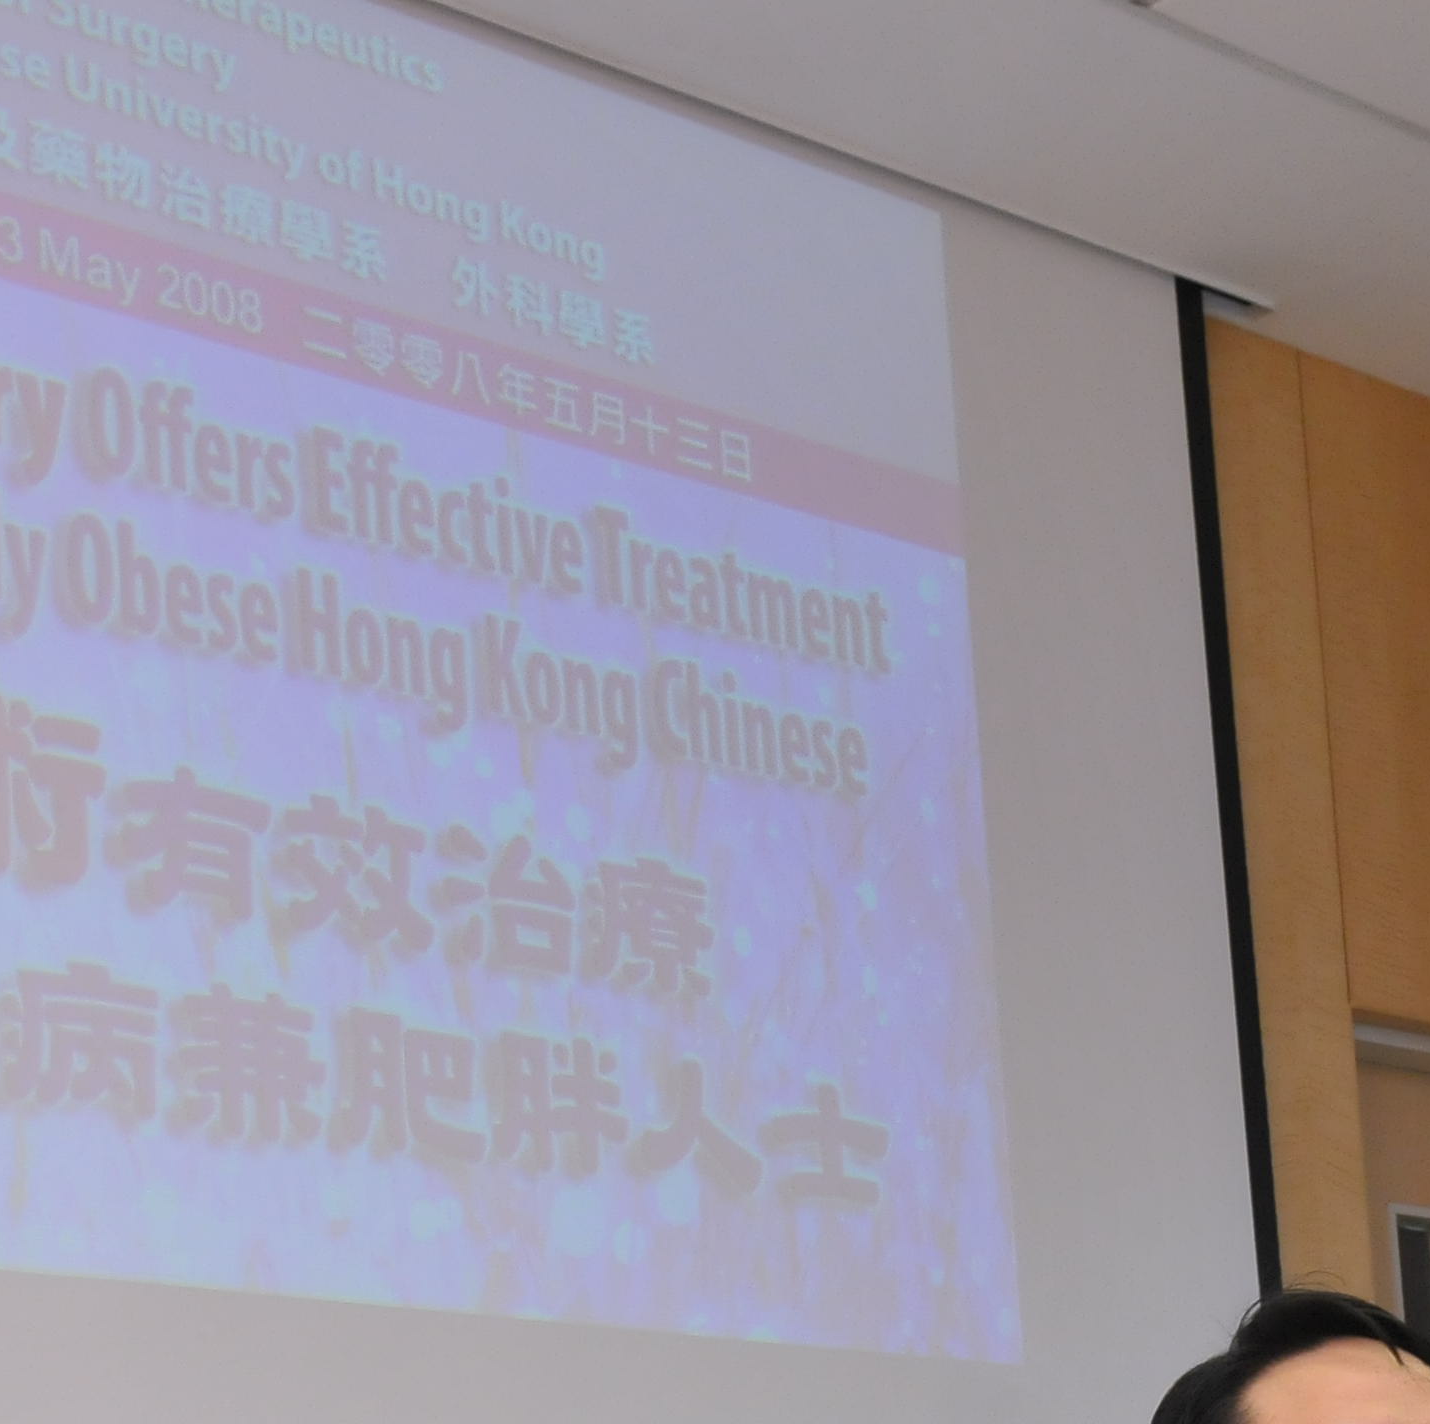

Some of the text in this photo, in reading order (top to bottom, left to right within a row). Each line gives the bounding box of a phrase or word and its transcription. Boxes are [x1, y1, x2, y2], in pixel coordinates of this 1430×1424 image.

[64, 50, 306, 182] University
[318, 133, 365, 190] of
[371, 153, 494, 245] Hong
[500, 193, 609, 283] Kong
[38, 226, 143, 306] May
[155, 263, 264, 334] 2008
[301, 303, 755, 486] 二零零八年五月十三日
[452, 256, 658, 367] 外科學系
[77, 366, 294, 518] Offers
[306, 425, 584, 600] Effective
[591, 506, 891, 673] Treatment
[63, 511, 279, 664] Obese
[289, 567, 466, 731] Hong
[483, 617, 638, 769] Kong
[650, 658, 868, 795] Chinese
